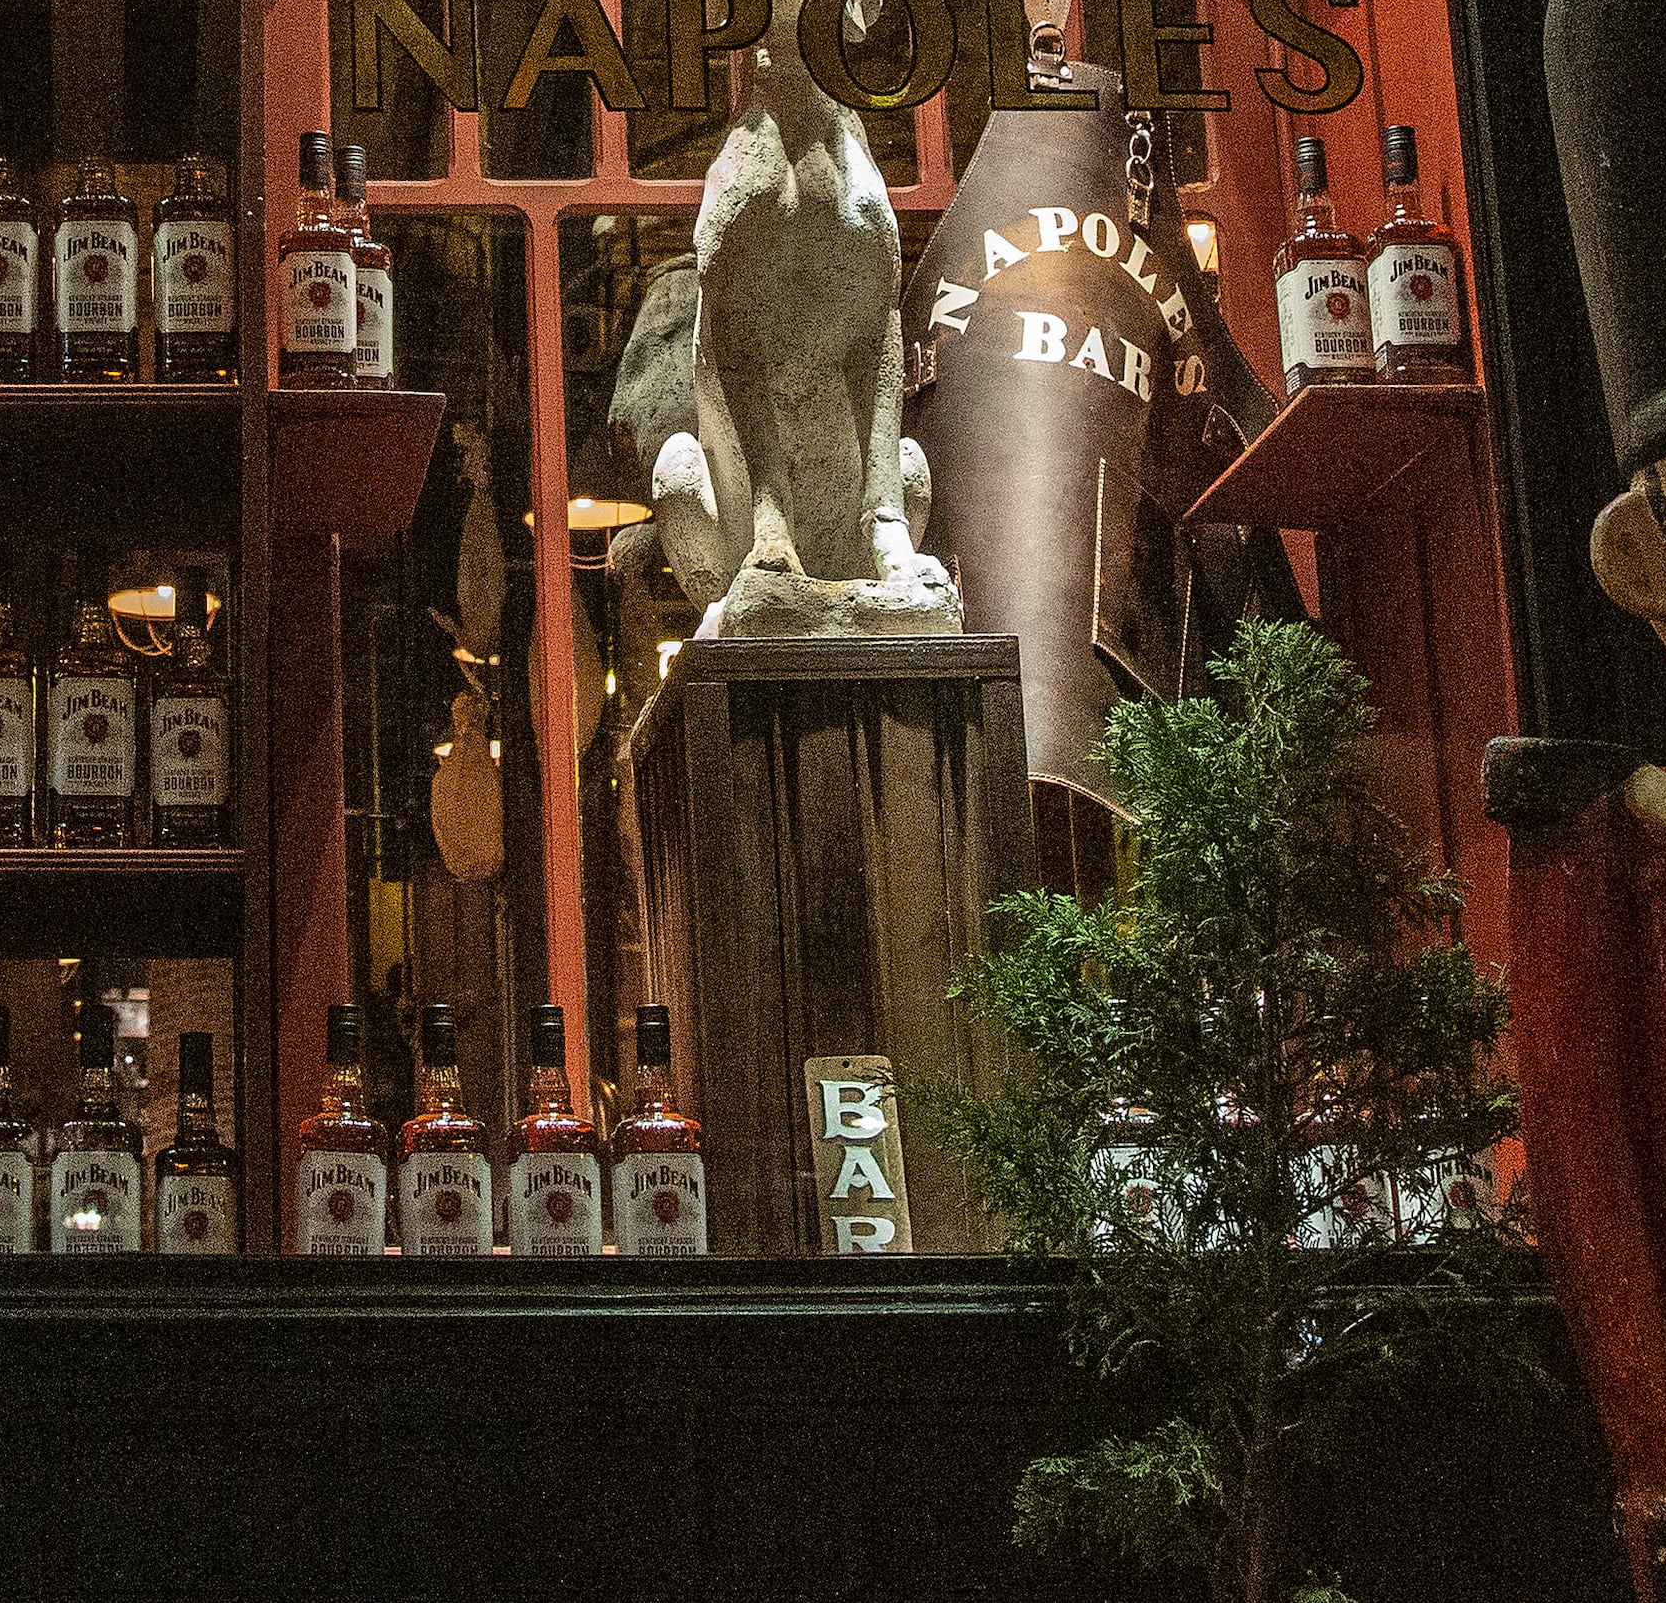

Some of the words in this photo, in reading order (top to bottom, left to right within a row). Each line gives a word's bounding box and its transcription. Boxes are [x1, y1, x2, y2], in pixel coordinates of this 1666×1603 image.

[63, 237, 90, 262] JIM
[91, 231, 128, 261] BEAM
[162, 238, 188, 263] JIM
[314, 261, 348, 289] BEAM
[1390, 260, 1413, 282] JIM
[1414, 254, 1448, 278] BEAM
[356, 282, 384, 309] EAM
[1305, 276, 1329, 299] JIM
[1330, 269, 1366, 294] BEAM
[68, 302, 122, 316] BOURBON
[928, 206, 1208, 395] NAPOLES
[1399, 317, 1449, 331] BOURBON
[1013, 311, 1152, 401] BAR
[1315, 339, 1367, 353] BOURBON
[62, 697, 90, 721] JIM
[91, 689, 129, 719] BEAM
[61, 1170, 89, 1197] JIM
[90, 1163, 129, 1196] BEAM
[819, 1079, 896, 1253] BAR
[307, 1169, 334, 1198] JIM
[413, 1171, 440, 1199] JIM
[442, 1165, 482, 1199] BEAM
[523, 1171, 550, 1199] JIM
[552, 1165, 592, 1198] BEAM
[630, 1171, 658, 1199] JIM
[659, 1165, 698, 1199] BEAM
